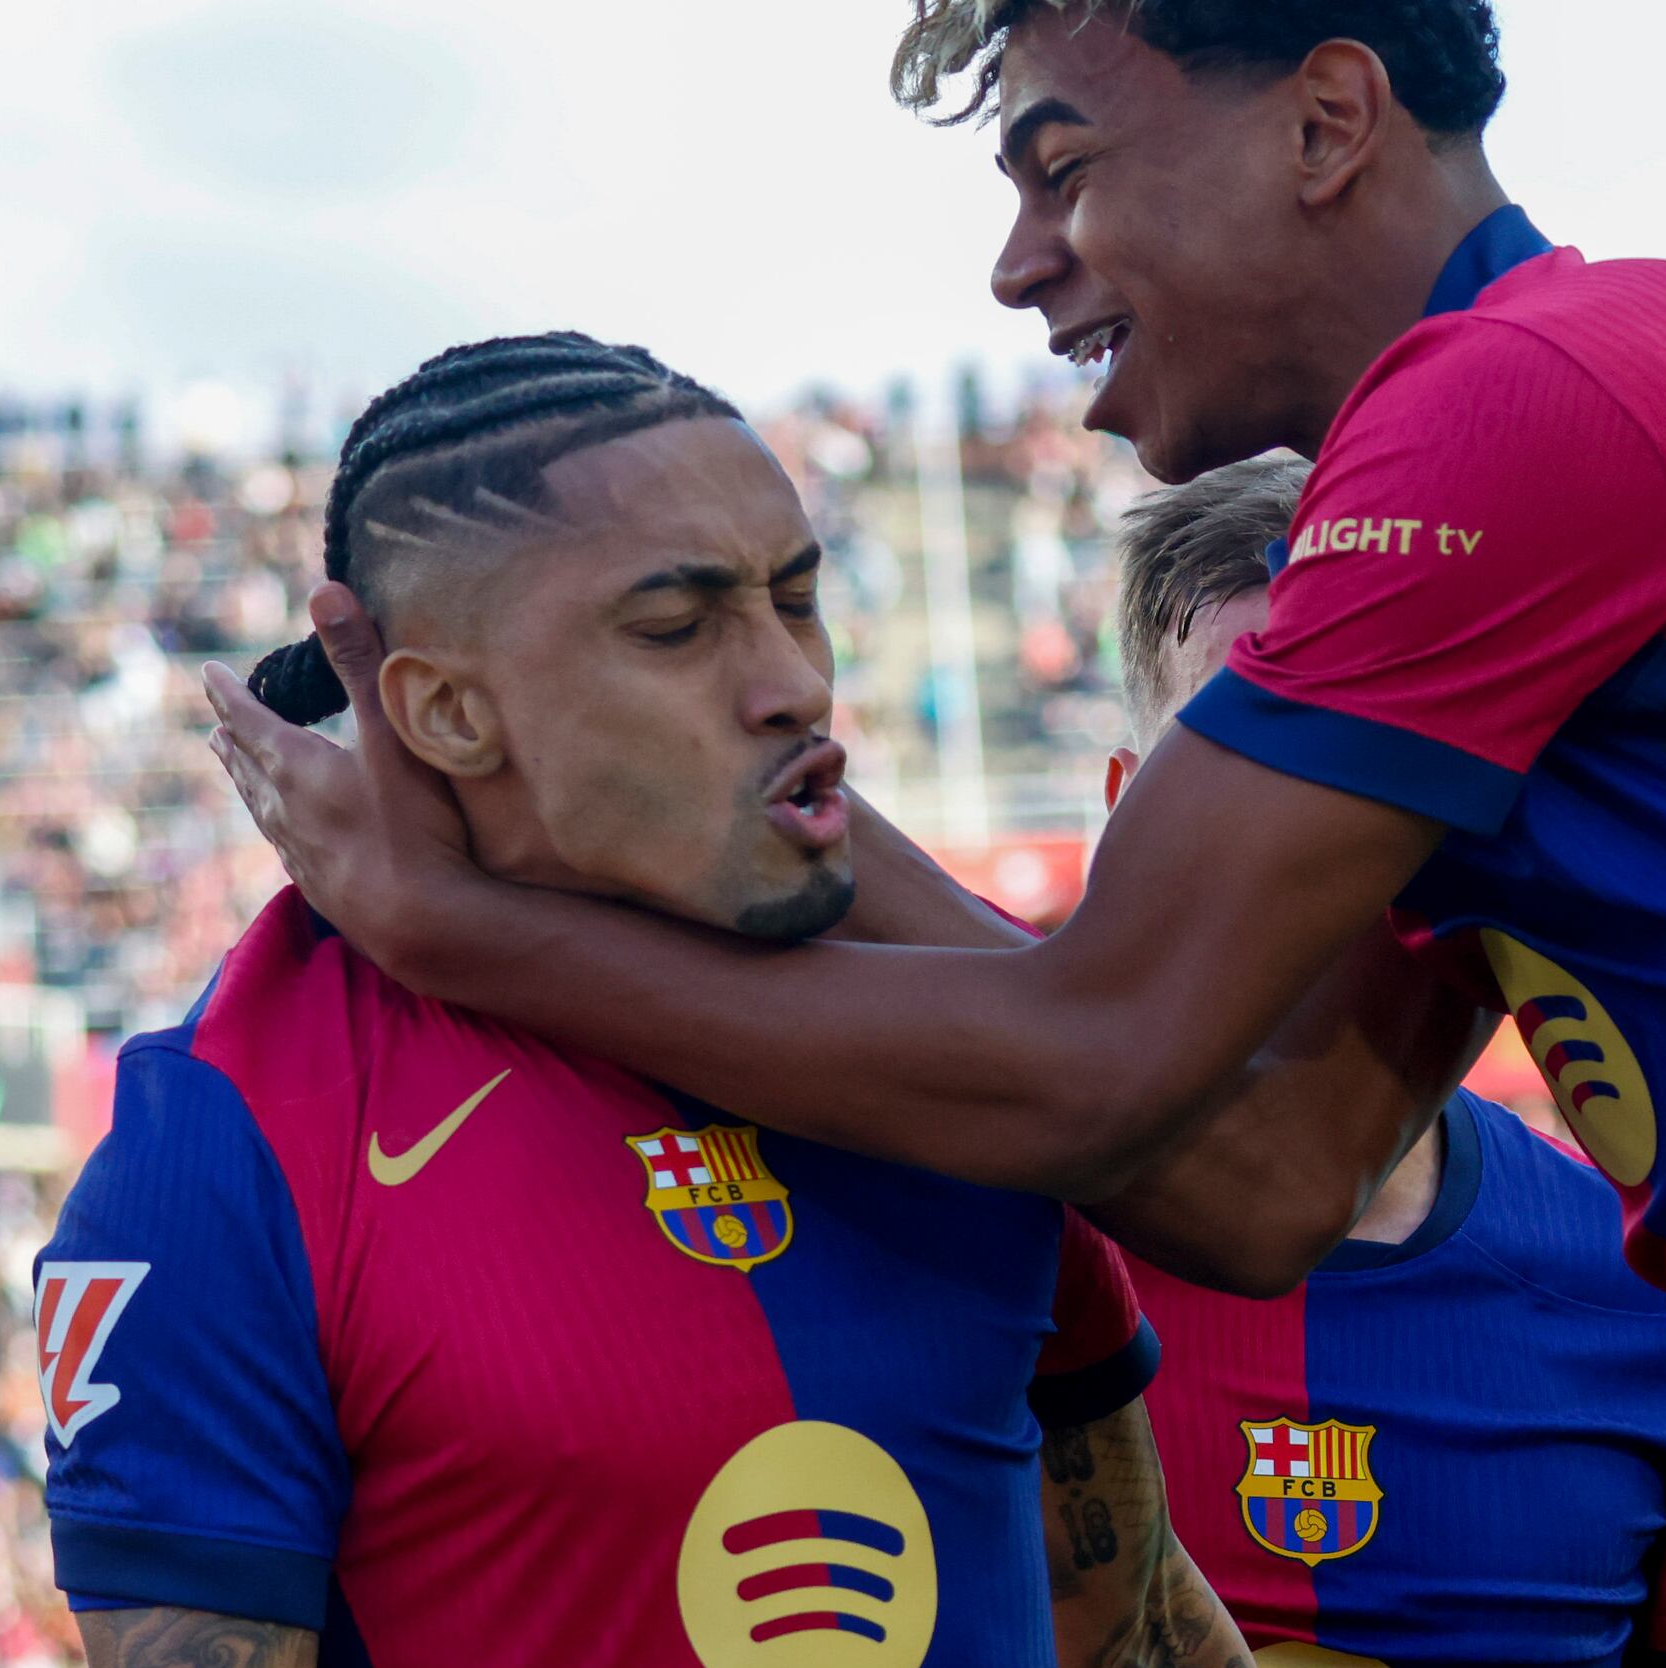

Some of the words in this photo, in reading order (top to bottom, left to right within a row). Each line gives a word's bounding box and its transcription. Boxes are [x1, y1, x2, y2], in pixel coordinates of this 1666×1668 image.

[1436, 522, 1483, 556] tv
[687, 1183, 744, 1205] FCB
[1282, 1478, 1337, 1498] FCB
